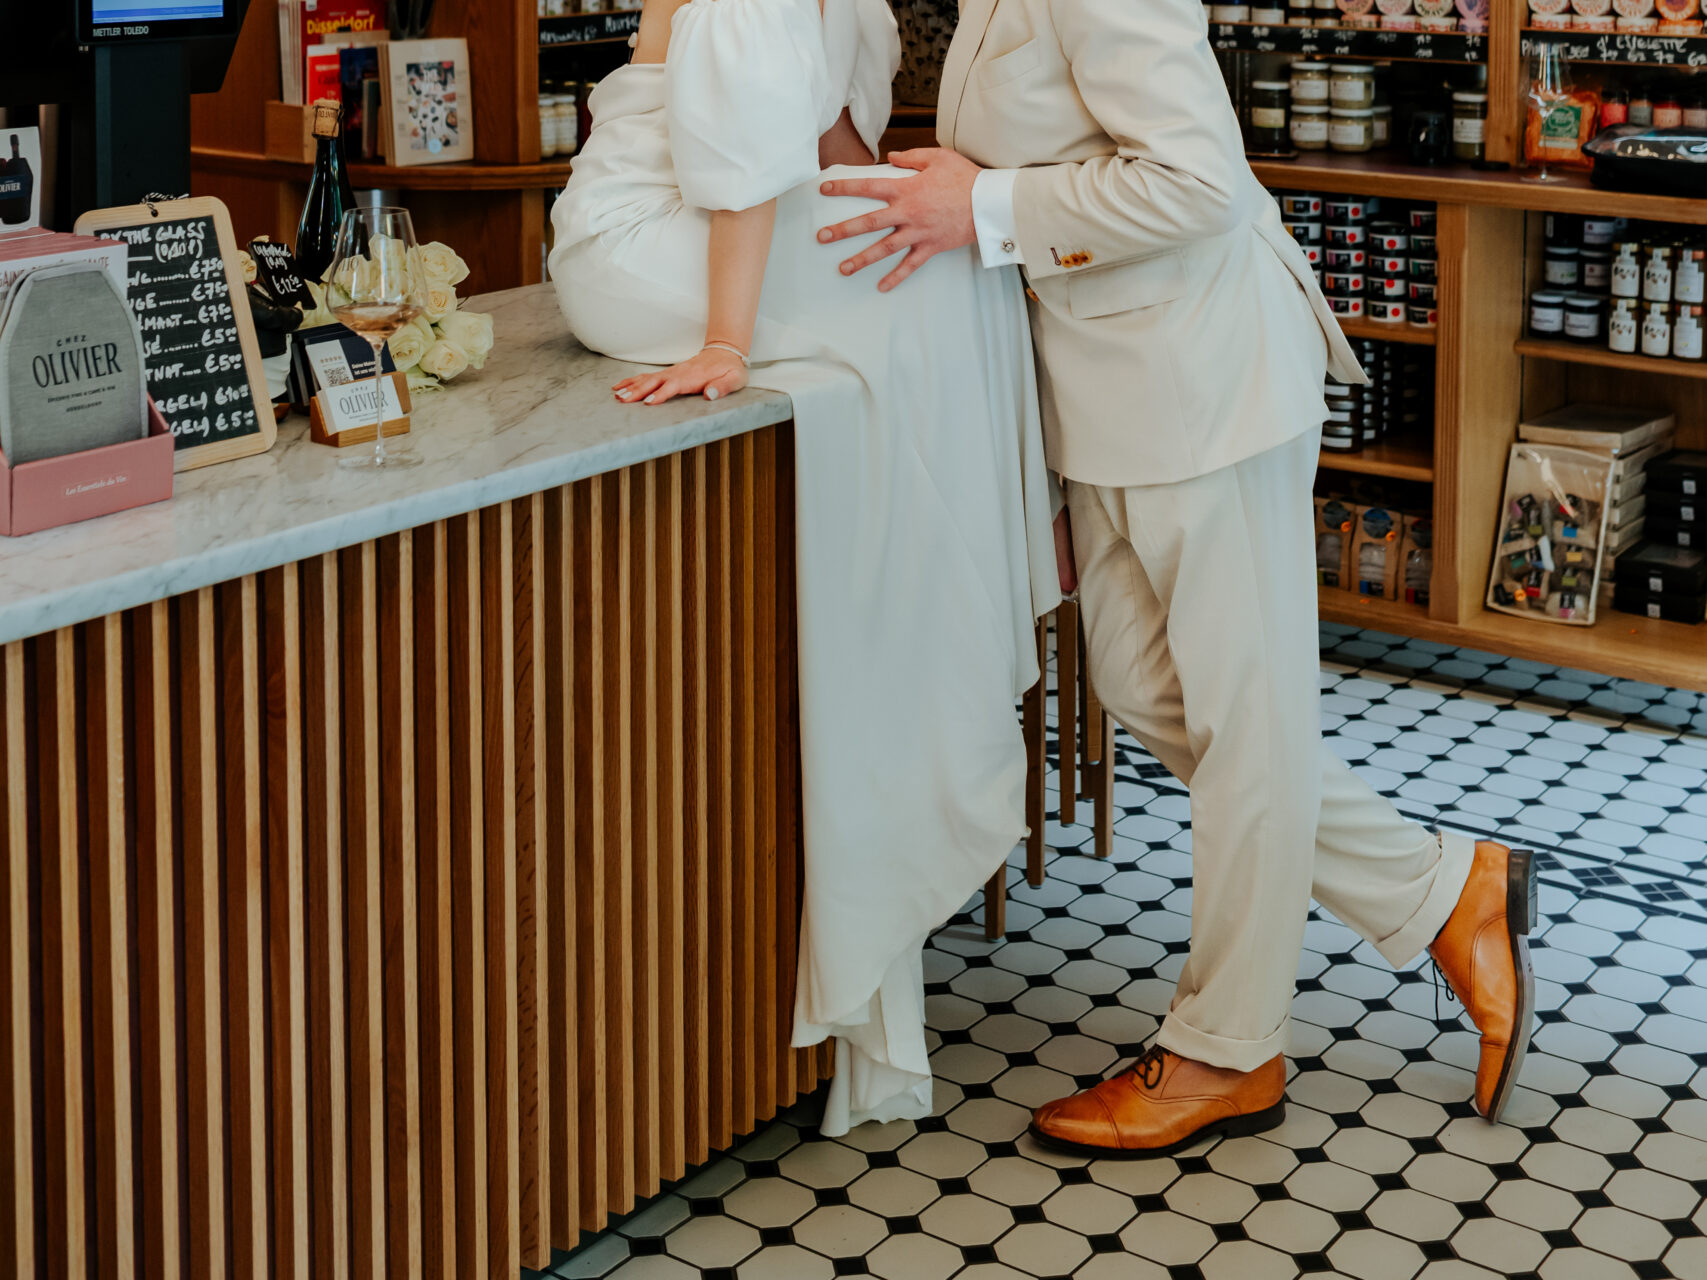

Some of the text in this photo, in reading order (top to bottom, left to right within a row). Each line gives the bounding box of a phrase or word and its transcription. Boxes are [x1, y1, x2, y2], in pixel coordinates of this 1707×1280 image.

[93, 25, 150, 37] METTLER TOLEDO
[306, 13, 376, 35] Düsseldorf
[122, 227, 152, 245] THE
[155, 221, 207, 243] GLASS
[56, 334, 87, 348] CHEZ
[32, 342, 123, 389] OLIVIER
[339, 391, 389, 415] OLIVIER
